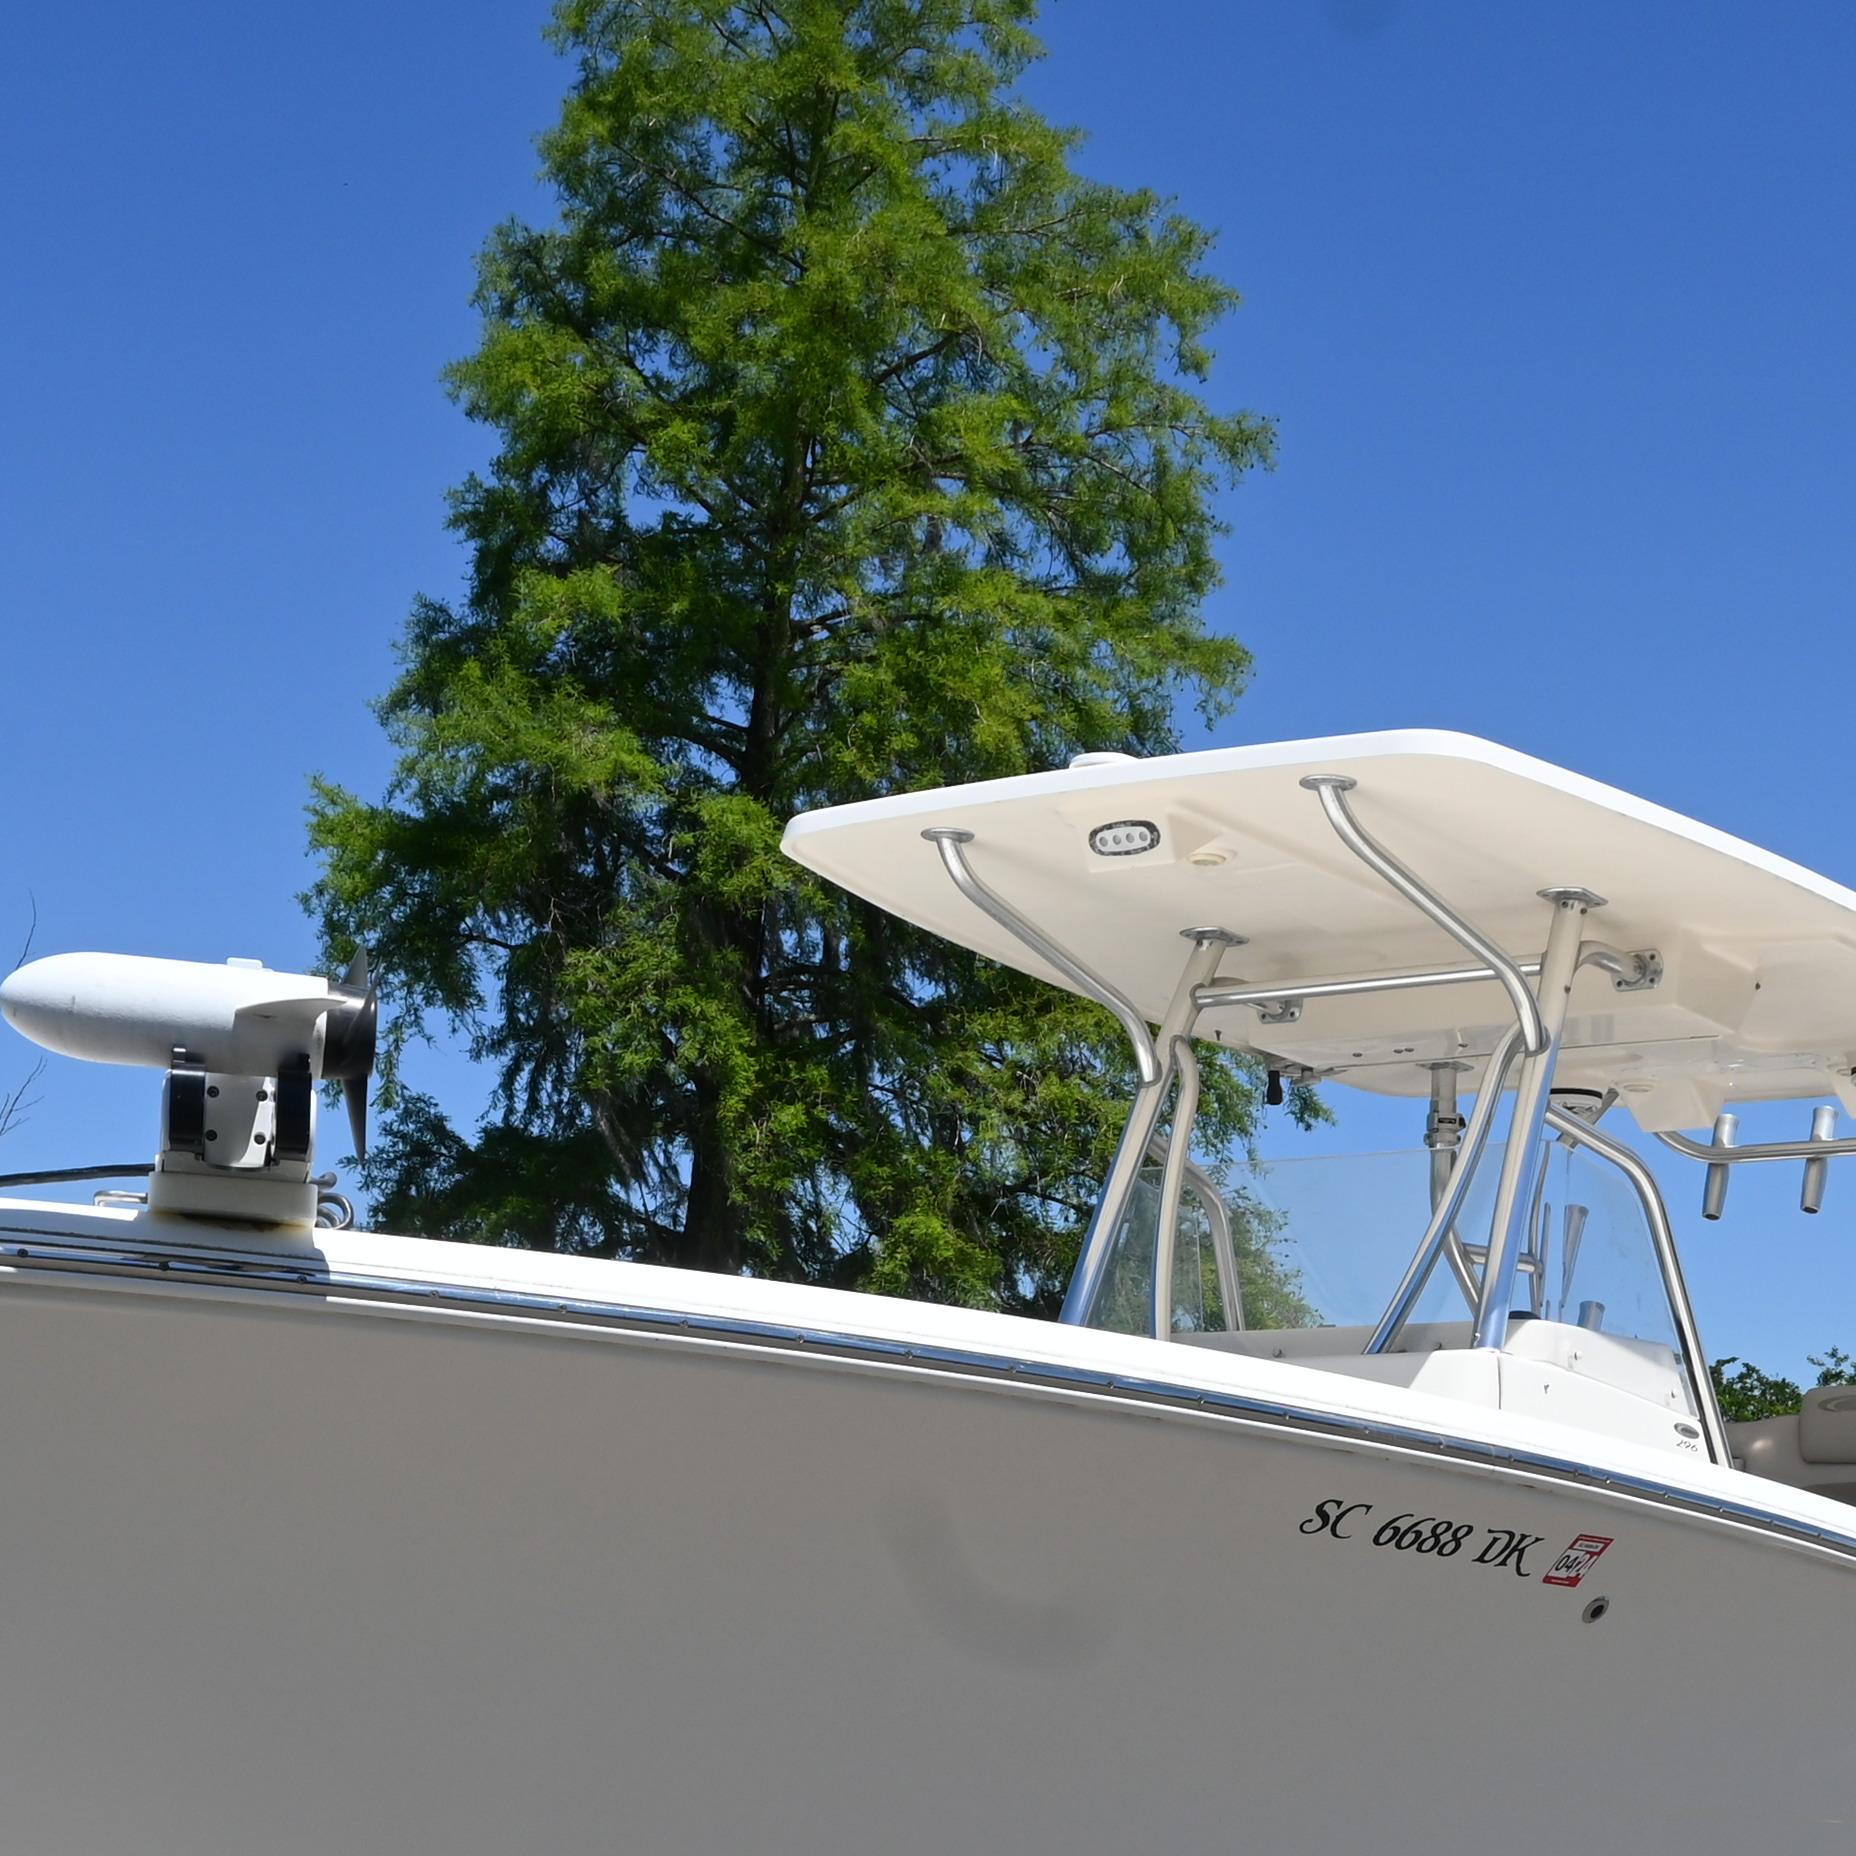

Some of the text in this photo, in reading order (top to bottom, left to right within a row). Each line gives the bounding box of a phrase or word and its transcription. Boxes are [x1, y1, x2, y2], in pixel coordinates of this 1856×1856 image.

[1299, 1499, 1546, 1577] SC 6688 DK
